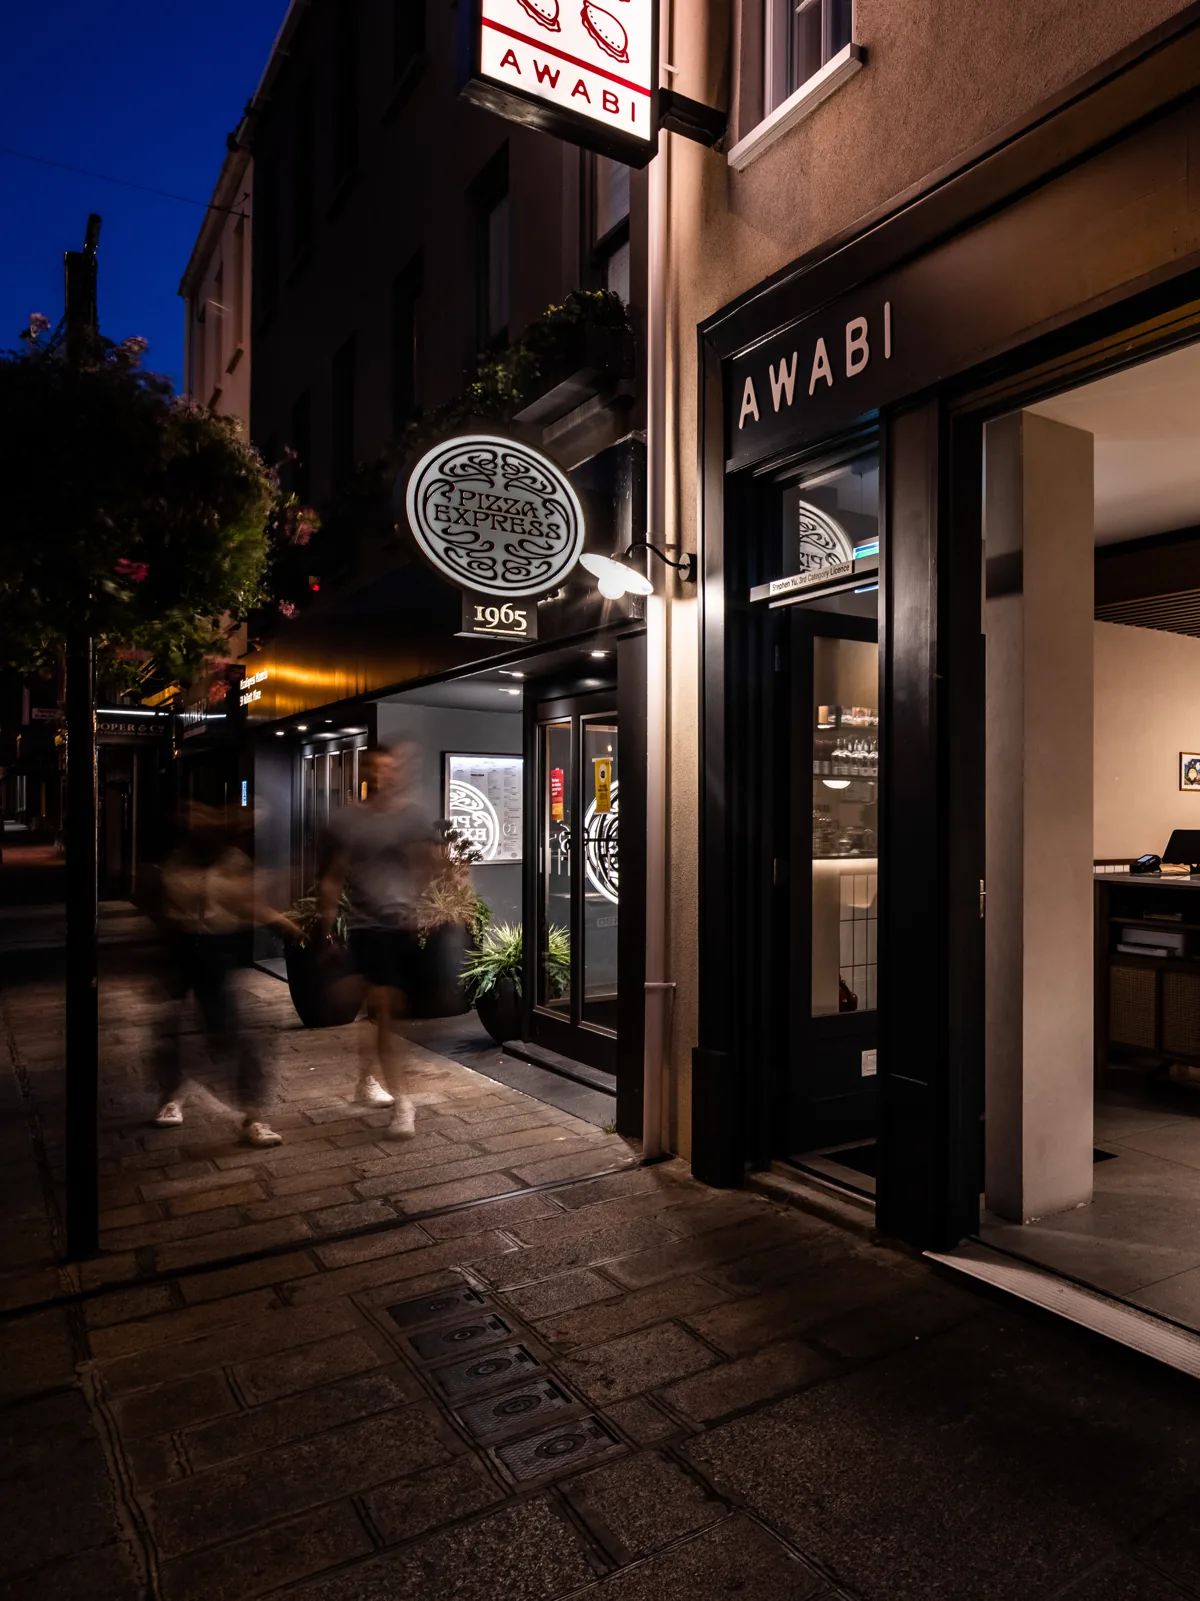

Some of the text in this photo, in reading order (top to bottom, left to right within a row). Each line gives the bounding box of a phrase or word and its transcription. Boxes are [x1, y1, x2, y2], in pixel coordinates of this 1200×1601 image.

[500, 48, 635, 123] AWABI
[738, 301, 891, 430] AWABI
[458, 489, 539, 519] PIZZA
[434, 503, 561, 540] EXPRESS
[799, 574, 807, 584] 3rd
[808, 570, 829, 581] Category
[830, 564, 850, 576] Licence
[474, 603, 527, 631] 1965
